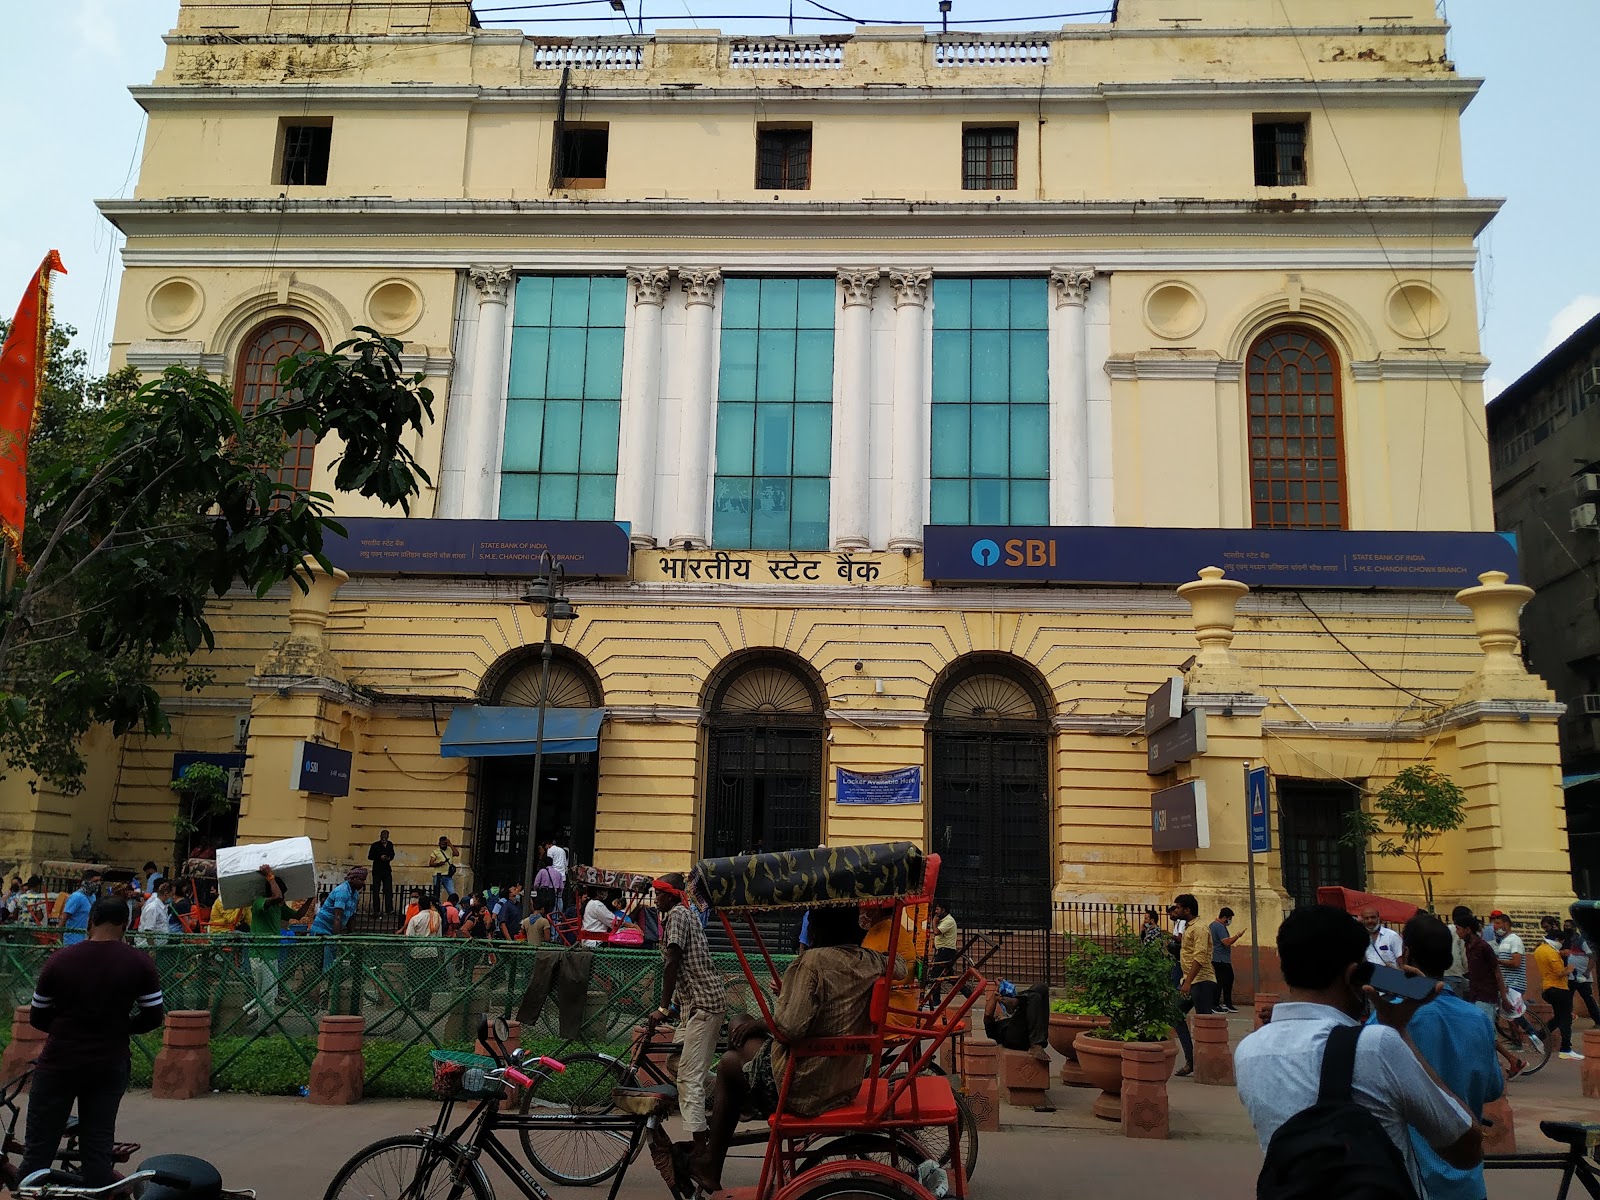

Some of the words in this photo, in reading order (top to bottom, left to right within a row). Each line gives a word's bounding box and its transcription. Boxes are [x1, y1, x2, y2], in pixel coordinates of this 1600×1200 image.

[659, 551, 752, 579] भारतीय
[767, 553, 821, 580] स्टेट
[837, 553, 881, 581] बैंक
[1004, 539, 1056, 567] SBI
[1374, 565, 1408, 573] CHANDNI
[520, 1169, 547, 1198] NEELAM
